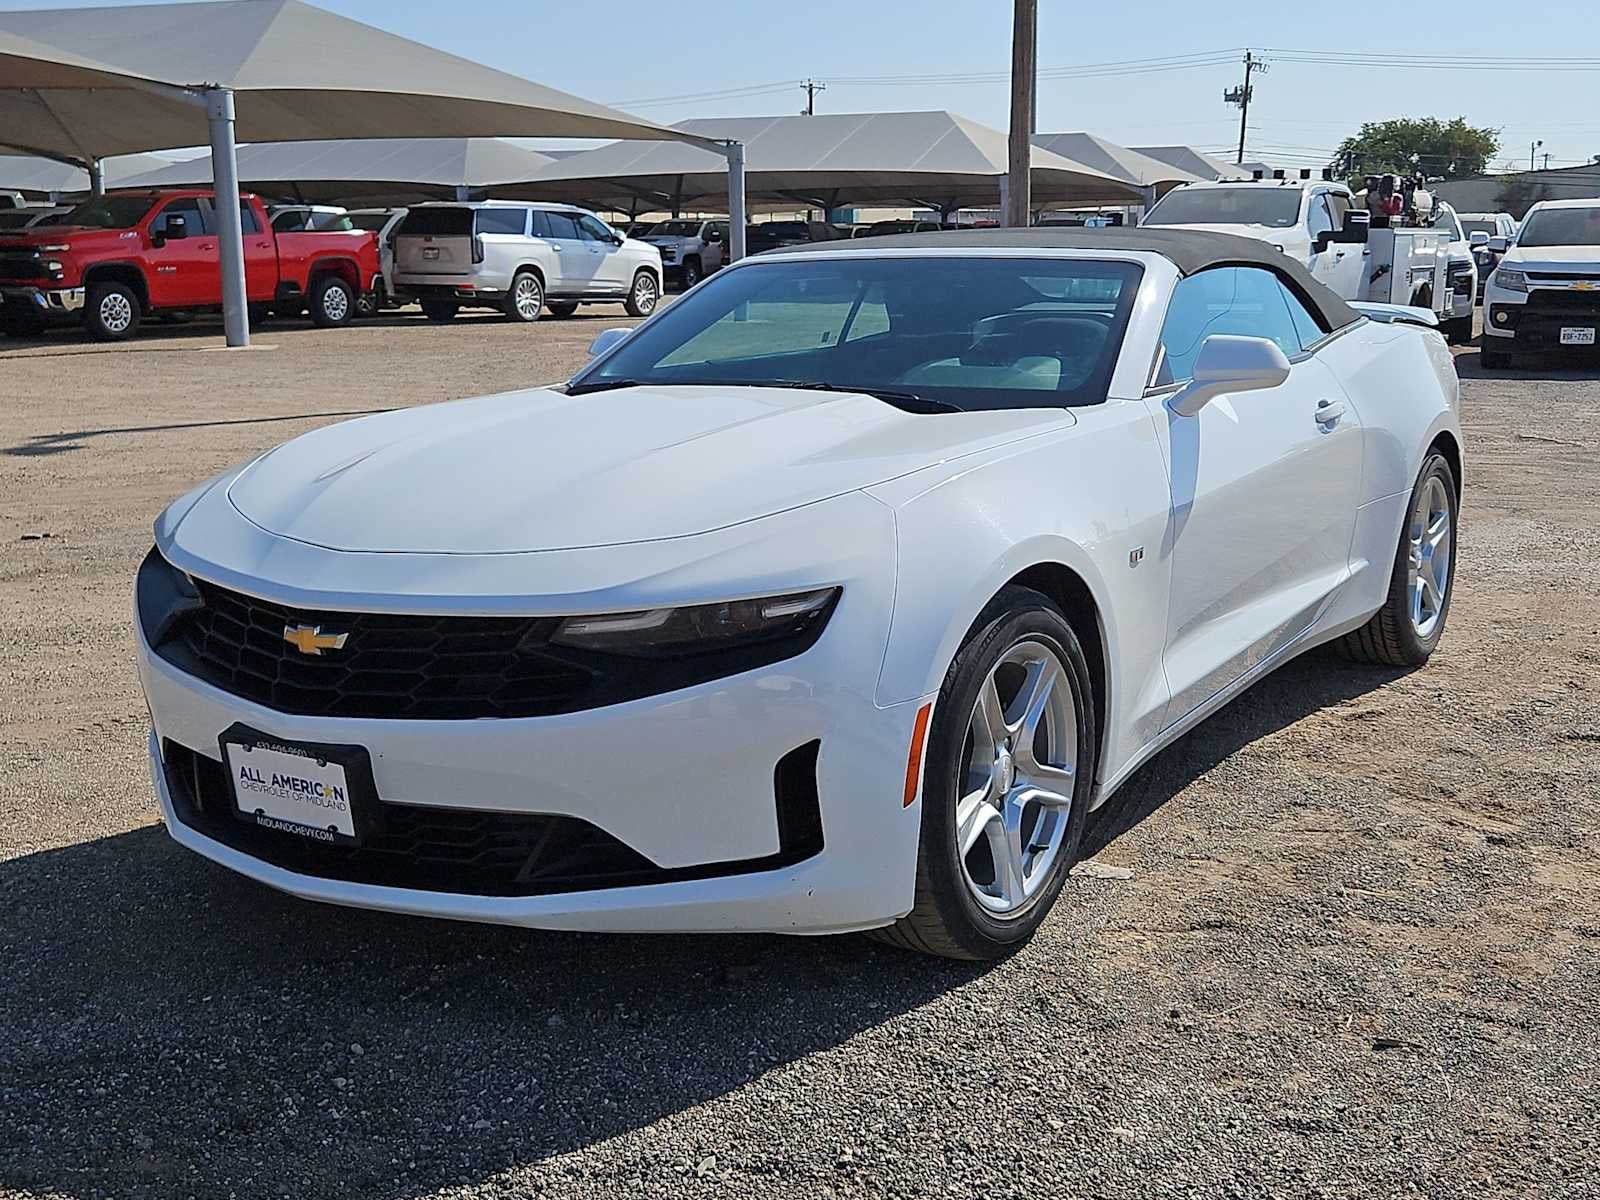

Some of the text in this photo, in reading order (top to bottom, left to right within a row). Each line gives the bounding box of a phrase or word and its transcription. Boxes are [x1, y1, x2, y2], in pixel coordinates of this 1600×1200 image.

[240, 766, 345, 801] ALL AMERICN
[240, 780, 347, 812] CHEVROLET OF MIDLAND
